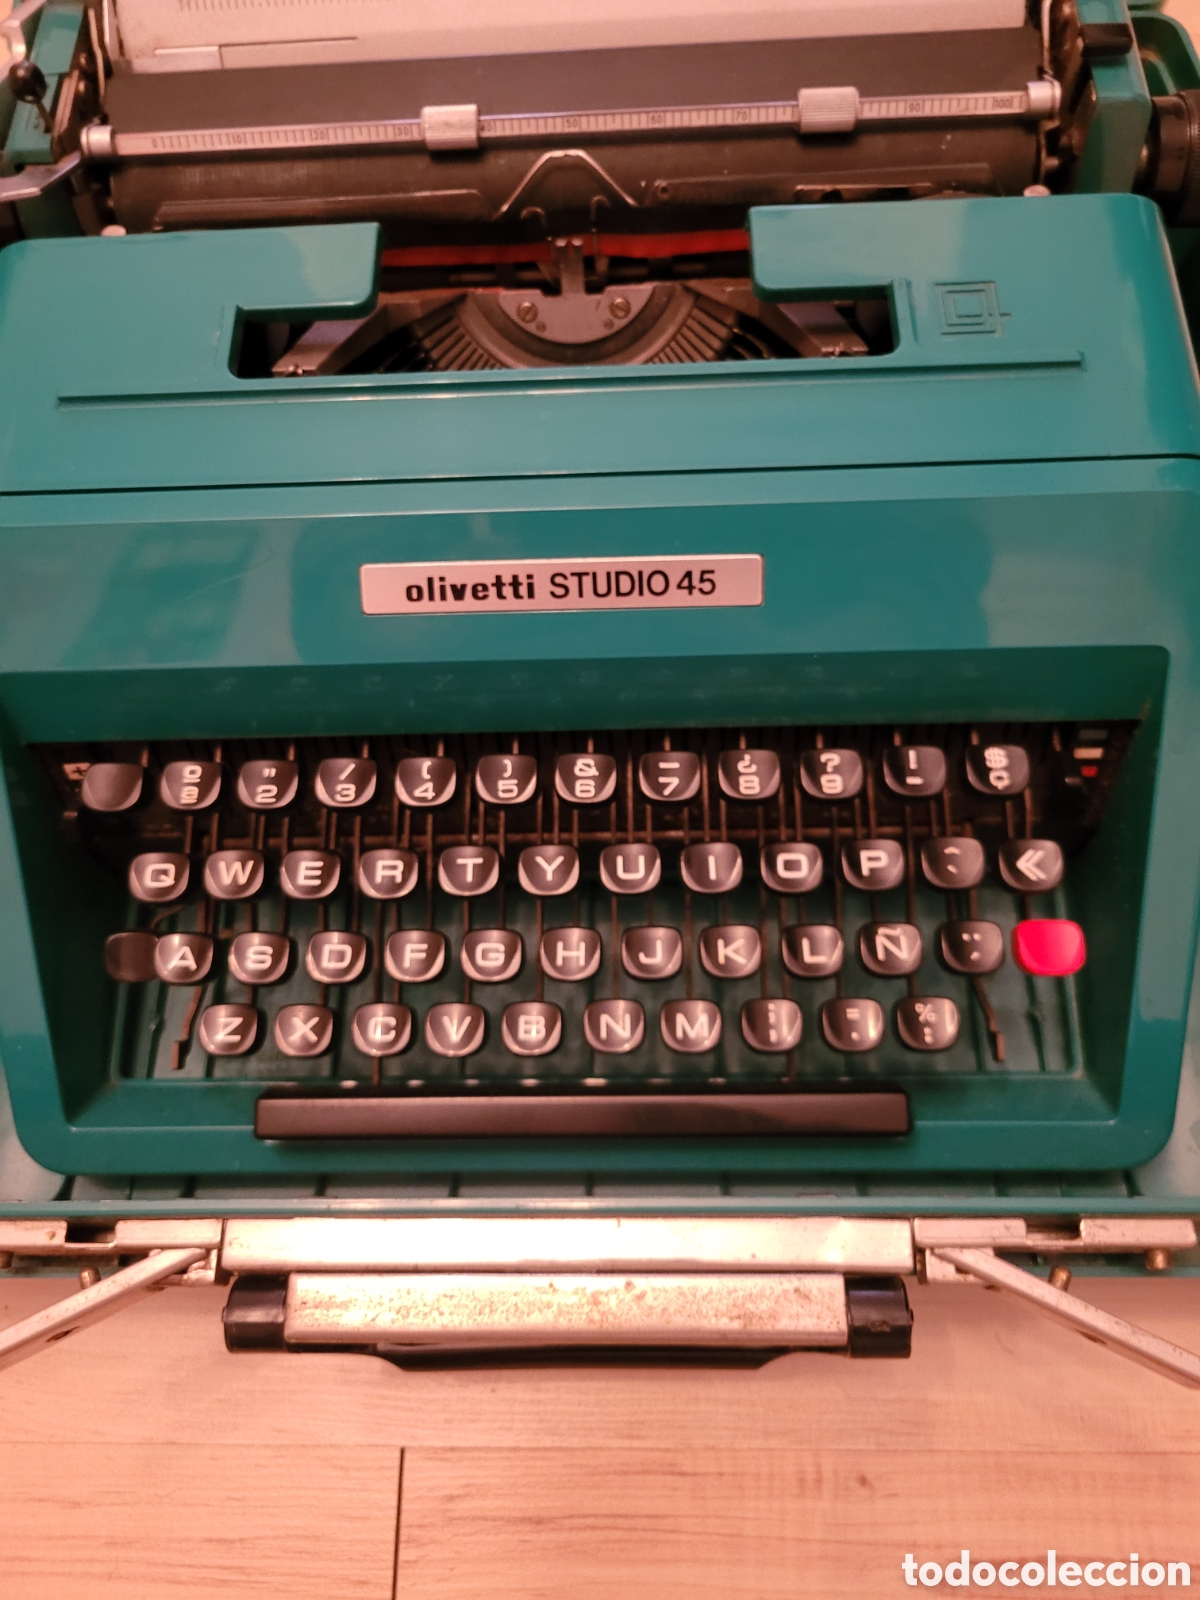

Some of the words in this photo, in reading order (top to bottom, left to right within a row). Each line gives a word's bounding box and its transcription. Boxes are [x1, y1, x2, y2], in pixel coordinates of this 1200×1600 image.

[566, 117, 579, 128] 50
[736, 110, 748, 121] 70
[908, 102, 921, 113] 90
[406, 574, 536, 602] olivetti
[549, 570, 670, 599] STUDIO
[676, 569, 716, 596] 45
[255, 784, 278, 803] 2
[334, 783, 356, 802] 3
[413, 782, 435, 800] 4
[497, 779, 518, 798] 5
[575, 779, 596, 798] 6
[658, 777, 680, 796] 7
[739, 774, 760, 795] 8
[820, 773, 844, 794] 9
[144, 863, 176, 888] Q
[218, 860, 255, 886] W
[297, 861, 324, 886] E
[375, 860, 404, 884] R
[456, 857, 484, 883] T
[535, 855, 564, 881] Y
[616, 855, 645, 880] U
[708, 855, 717, 881] I
[776, 852, 809, 879] O
[860, 849, 889, 877] P
[321, 944, 352, 969] D
[404, 943, 428, 969] F
[475, 942, 506, 967] G
[556, 941, 586, 967] H
[638, 939, 663, 965] J
[717, 938, 747, 965] K
[802, 937, 830, 964] L
[875, 926, 910, 961] Ñ
[167, 946, 197, 971] A
[247, 945, 273, 970] S
[215, 1017, 244, 1042] Z
[288, 1017, 320, 1042] X
[367, 1016, 397, 1043] C
[442, 1015, 472, 1044] V
[518, 1014, 546, 1041] B
[600, 1013, 632, 1040] N
[675, 1012, 710, 1040] M
